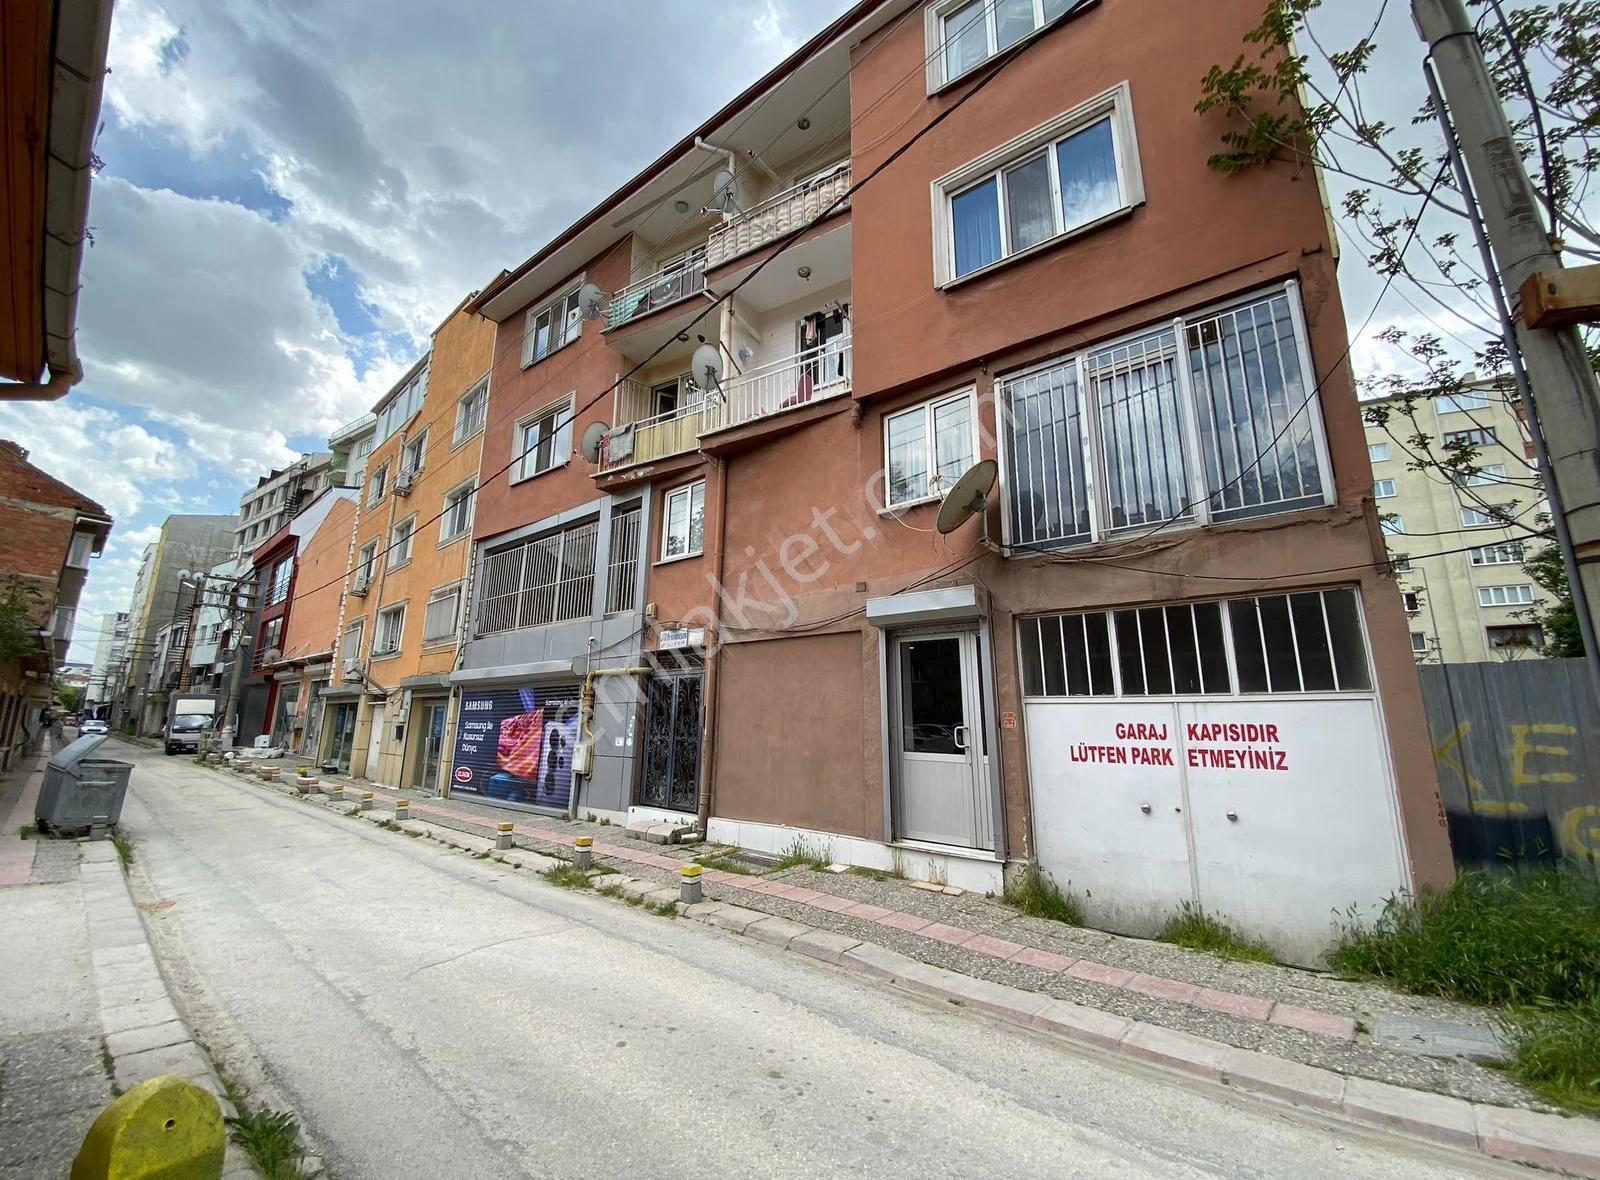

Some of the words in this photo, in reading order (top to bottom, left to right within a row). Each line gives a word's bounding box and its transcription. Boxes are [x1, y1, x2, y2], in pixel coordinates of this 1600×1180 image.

[464, 700, 493, 711] SAMSUNG
[464, 721, 487, 732] Samsung
[462, 732, 485, 741] Kusursuz
[1115, 722, 1168, 741] GARAJ
[1187, 723, 1280, 743] KAPISIDIR
[1070, 742, 1126, 764] LÜTFEN
[1132, 747, 1175, 766] PARK
[1187, 746, 1289, 771] ETMEYİNİZ
